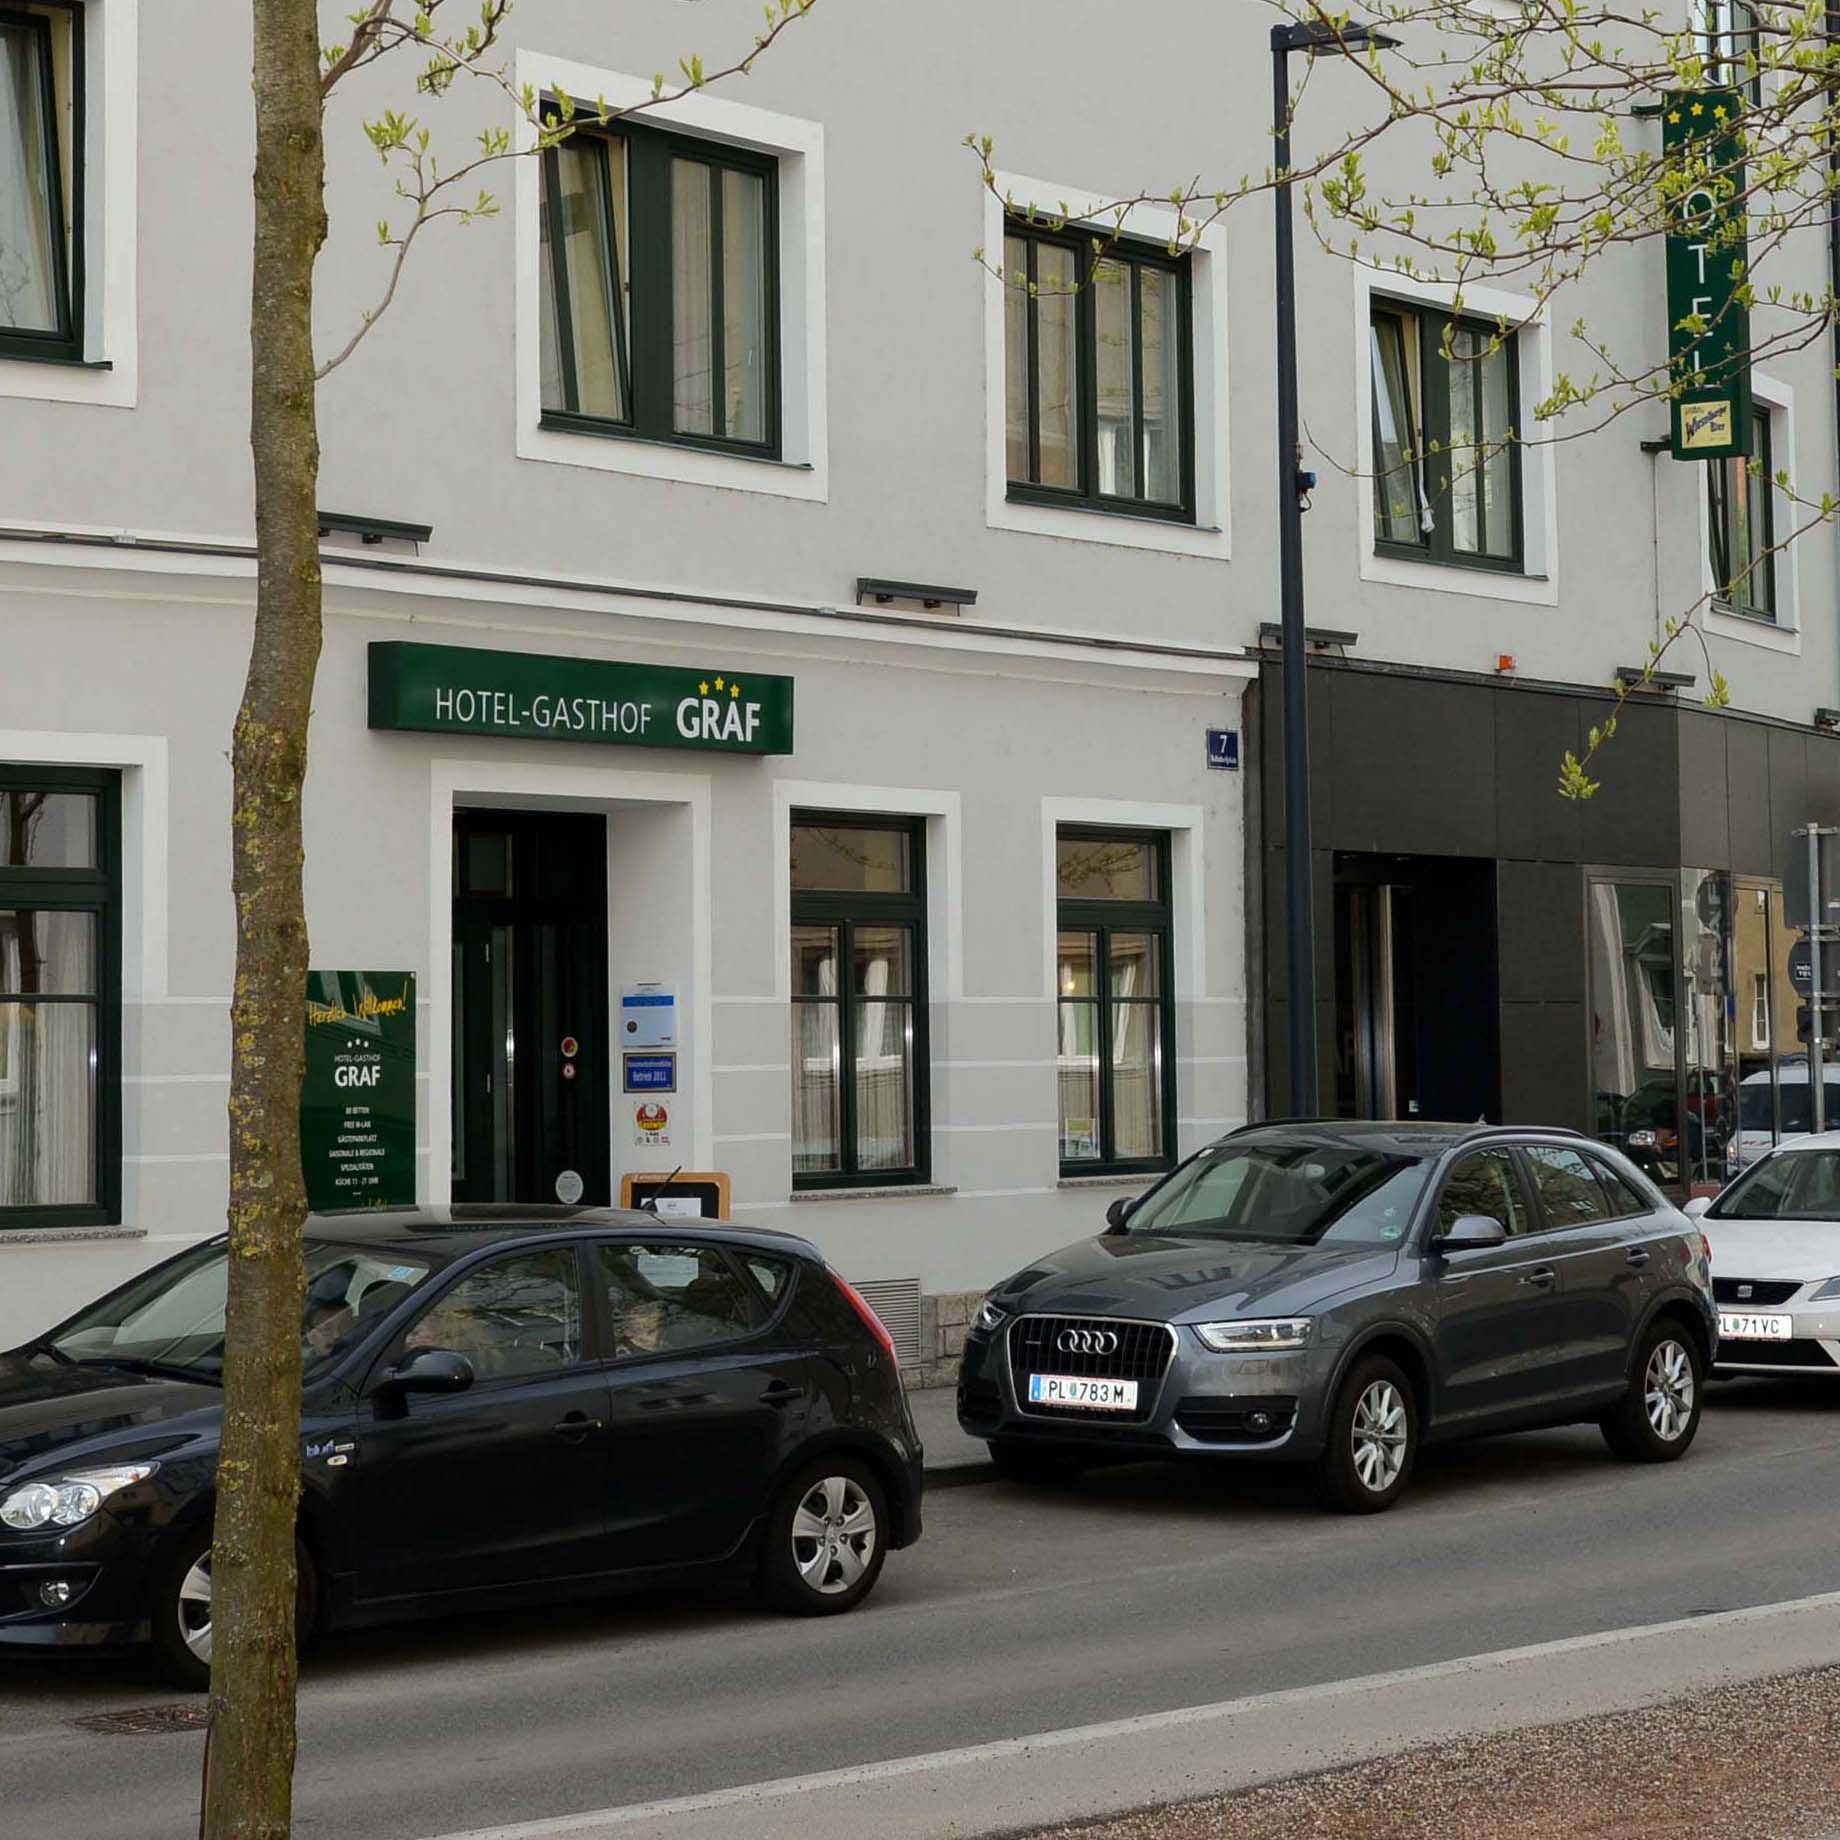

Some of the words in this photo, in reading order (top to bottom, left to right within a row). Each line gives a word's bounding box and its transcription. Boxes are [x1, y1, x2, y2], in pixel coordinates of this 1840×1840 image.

[435, 687, 652, 735] HOTEL-GASTHOF
[676, 697, 761, 743] GRAF
[1220, 734, 1228, 753] 7
[334, 1054, 381, 1063] HOTEL-GASTHOF
[334, 1065, 381, 1087] GRAF
[1742, 1318, 1758, 1334] 71
[1761, 1318, 1780, 1334] VC
[1048, 1380, 1066, 1399] PL
[1080, 1382, 1109, 1402] 783
[1113, 1385, 1125, 1404] M
